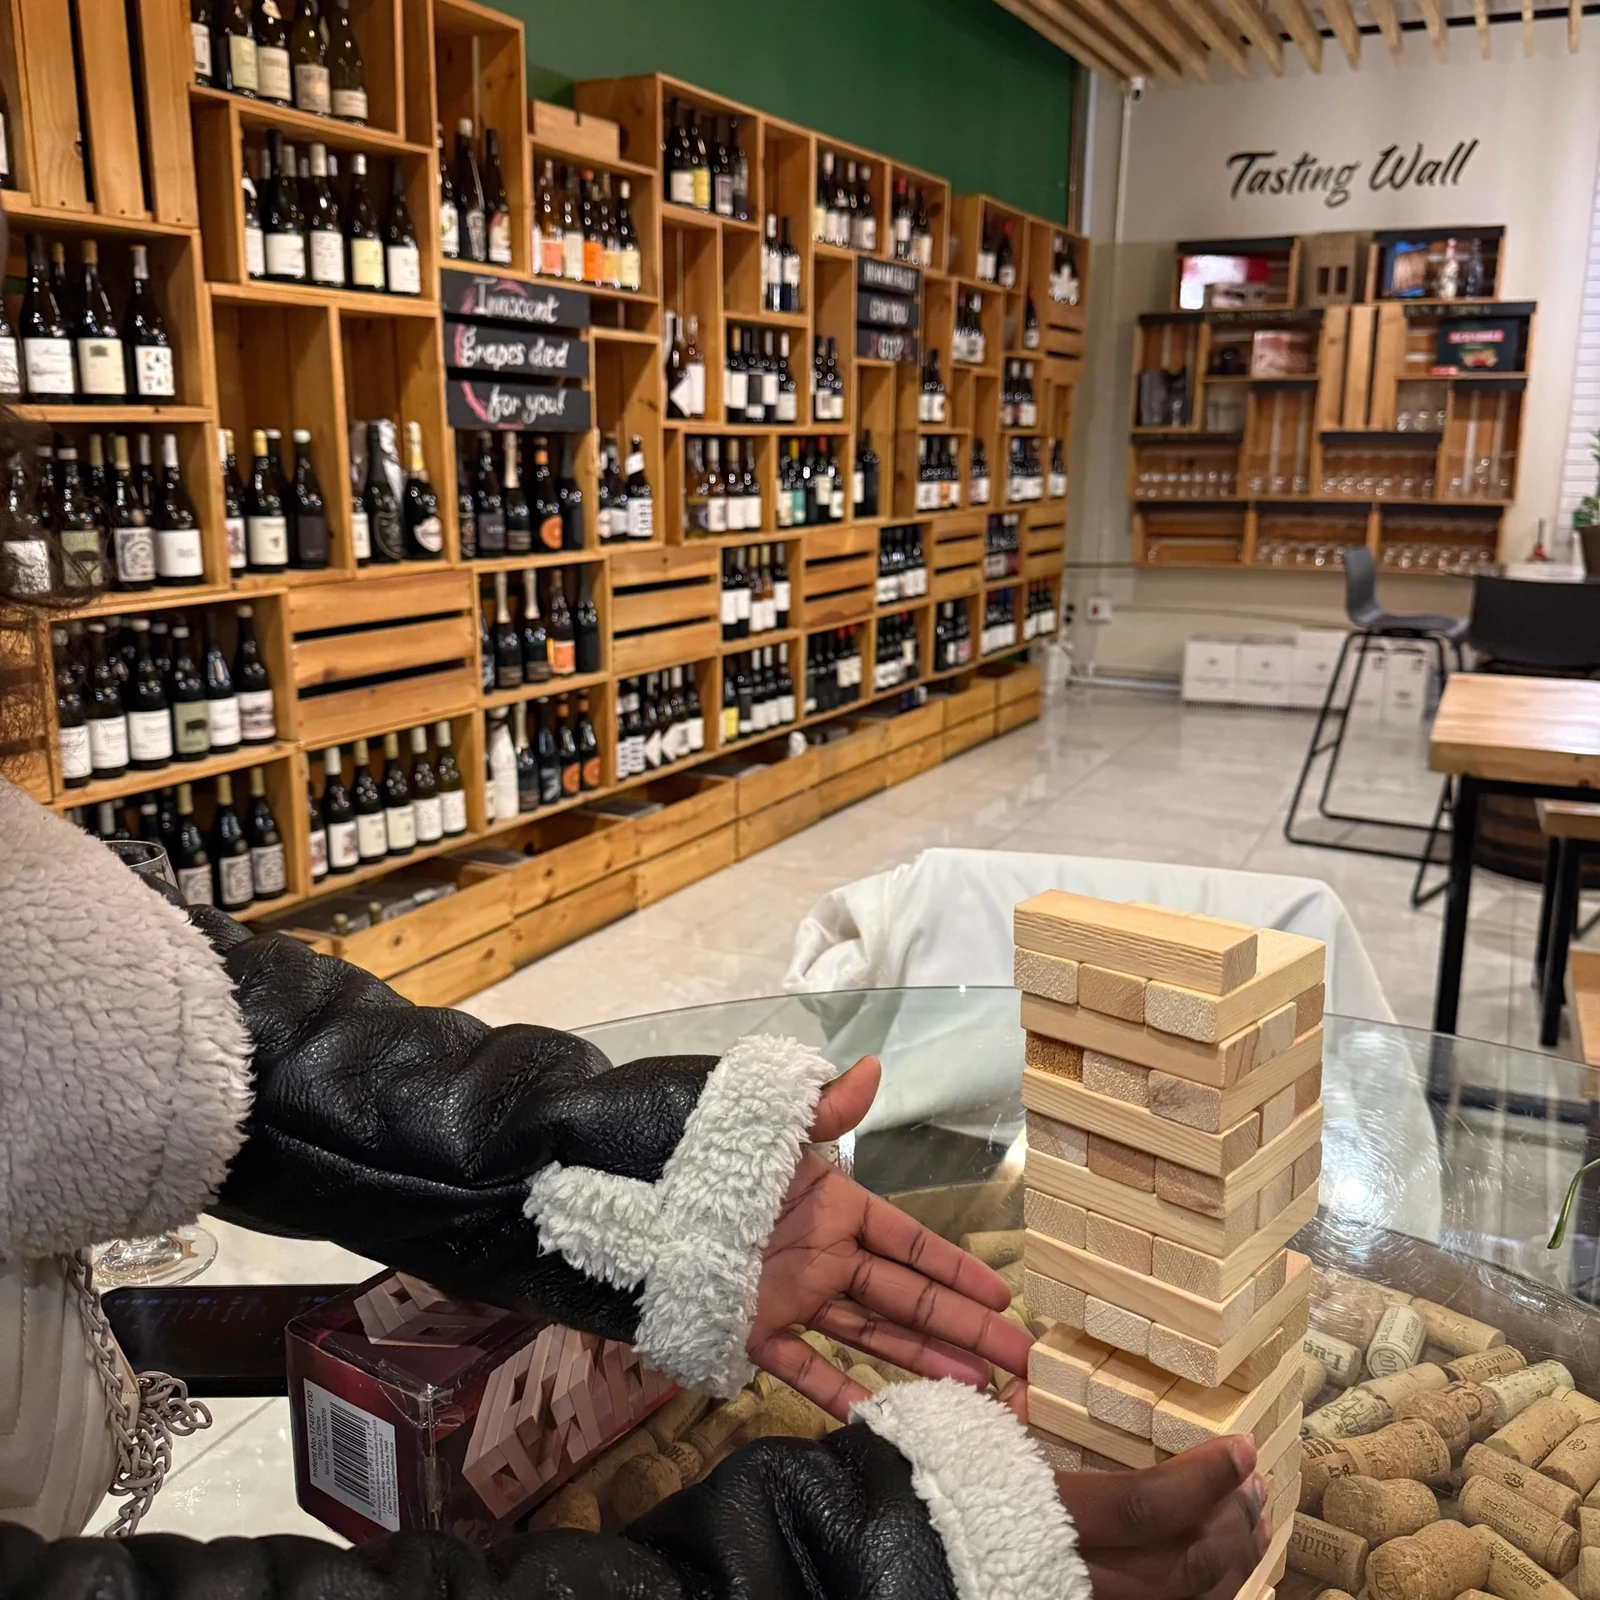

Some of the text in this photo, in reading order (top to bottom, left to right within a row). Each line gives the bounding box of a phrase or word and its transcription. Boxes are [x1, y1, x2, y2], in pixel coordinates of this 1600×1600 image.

[1226, 138, 1479, 208] Tasting Wall
[473, 276, 560, 323] Innocent
[462, 325, 570, 371] Grapes died
[487, 384, 521, 424] for
[307, 1390, 316, 1435] 174971-00
[1518, 1562, 1549, 1586] SOUTH
